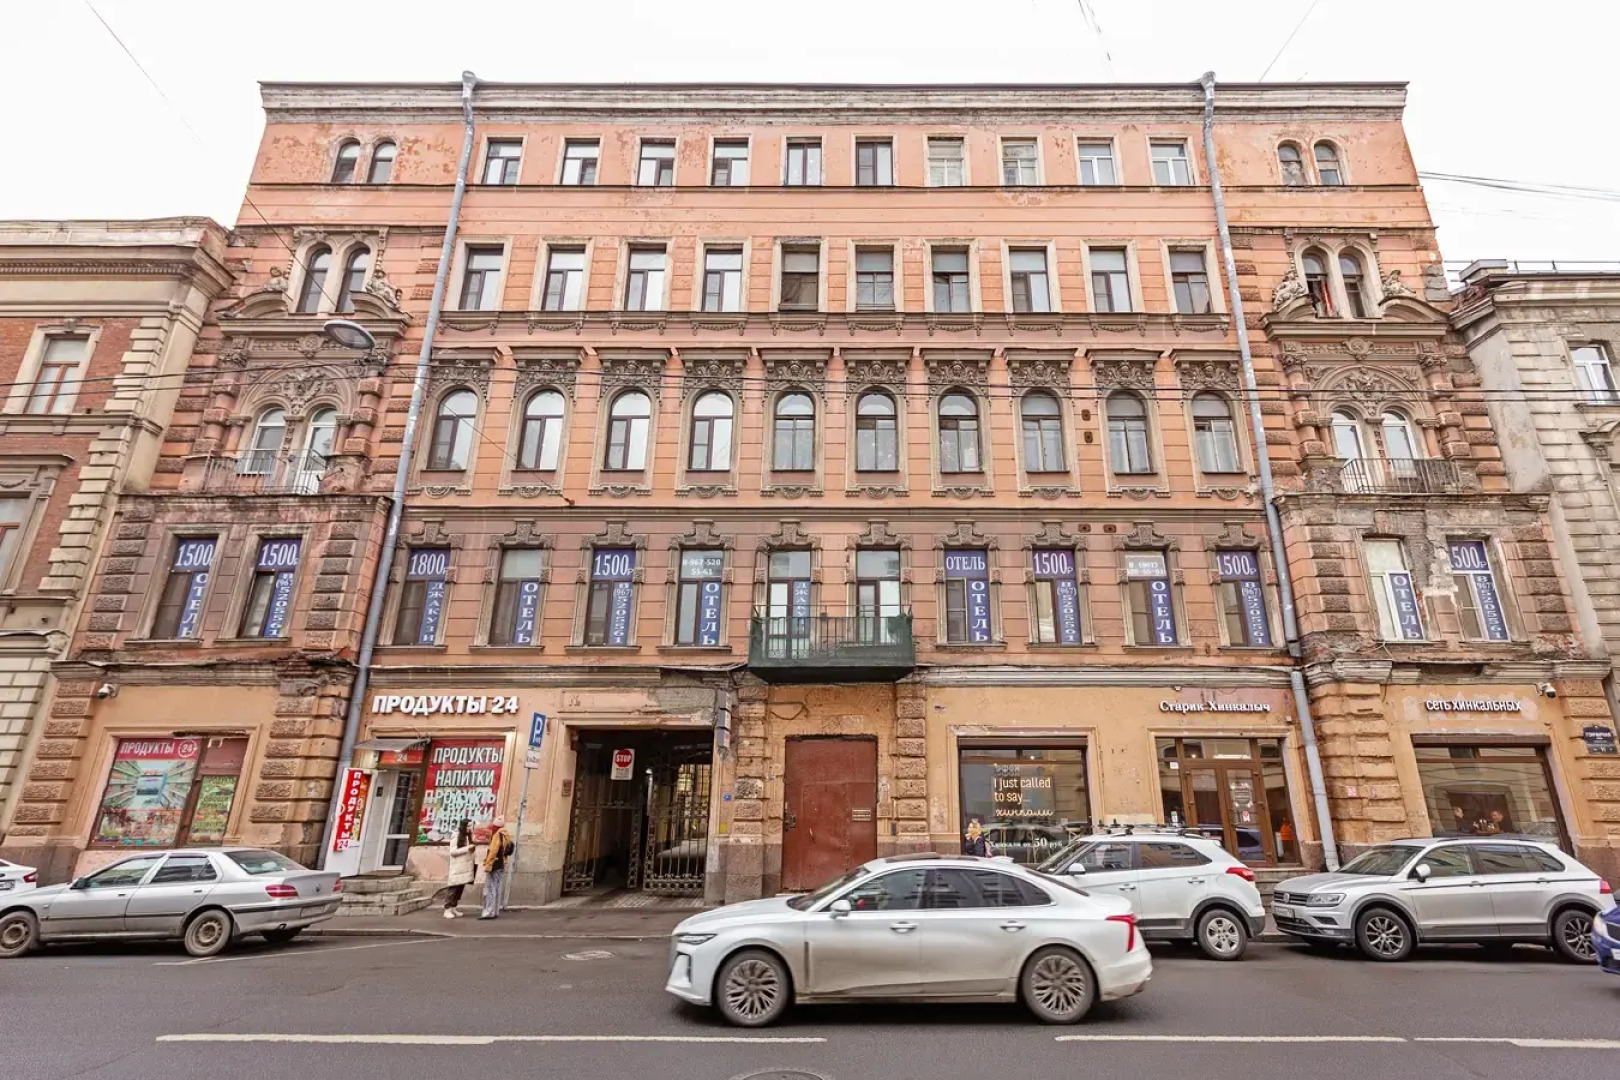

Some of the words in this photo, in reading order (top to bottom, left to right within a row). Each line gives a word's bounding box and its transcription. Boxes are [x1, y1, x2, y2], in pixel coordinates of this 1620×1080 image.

[946, 556, 986, 571] ОТЕЛЬ
[422, 583, 445, 642] ДЖАКУЗИ
[517, 583, 539, 643] ОТЕЛЬ
[701, 583, 720, 645] ОТЕЛЬ
[971, 581, 988, 642] ОТЕЛЬ
[1151, 581, 1173, 643] ОТЕЛЬ
[1392, 575, 1420, 638] ОТЕЛЬ
[372, 695, 487, 716] ПРОДУКТЫ
[491, 695, 519, 714] 24
[1159, 700, 1205, 713] Старик
[1208, 700, 1271, 712] Хинкалыч
[1426, 700, 1452, 711] сеть
[1453, 700, 1521, 711] хинкальных
[120, 742, 175, 756] ПРОДУКТЫ
[433, 747, 504, 764] ПРОДУКТЫ
[616, 754, 632, 763] STOP
[435, 769, 495, 787] НАПИТКИ
[999, 777, 1019, 791] just
[1020, 777, 1051, 788] called
[341, 771, 362, 839] ПРОДУКТЫ
[994, 791, 1005, 802] to
[338, 840, 349, 849] 24
[1034, 837, 1048, 847] 50
